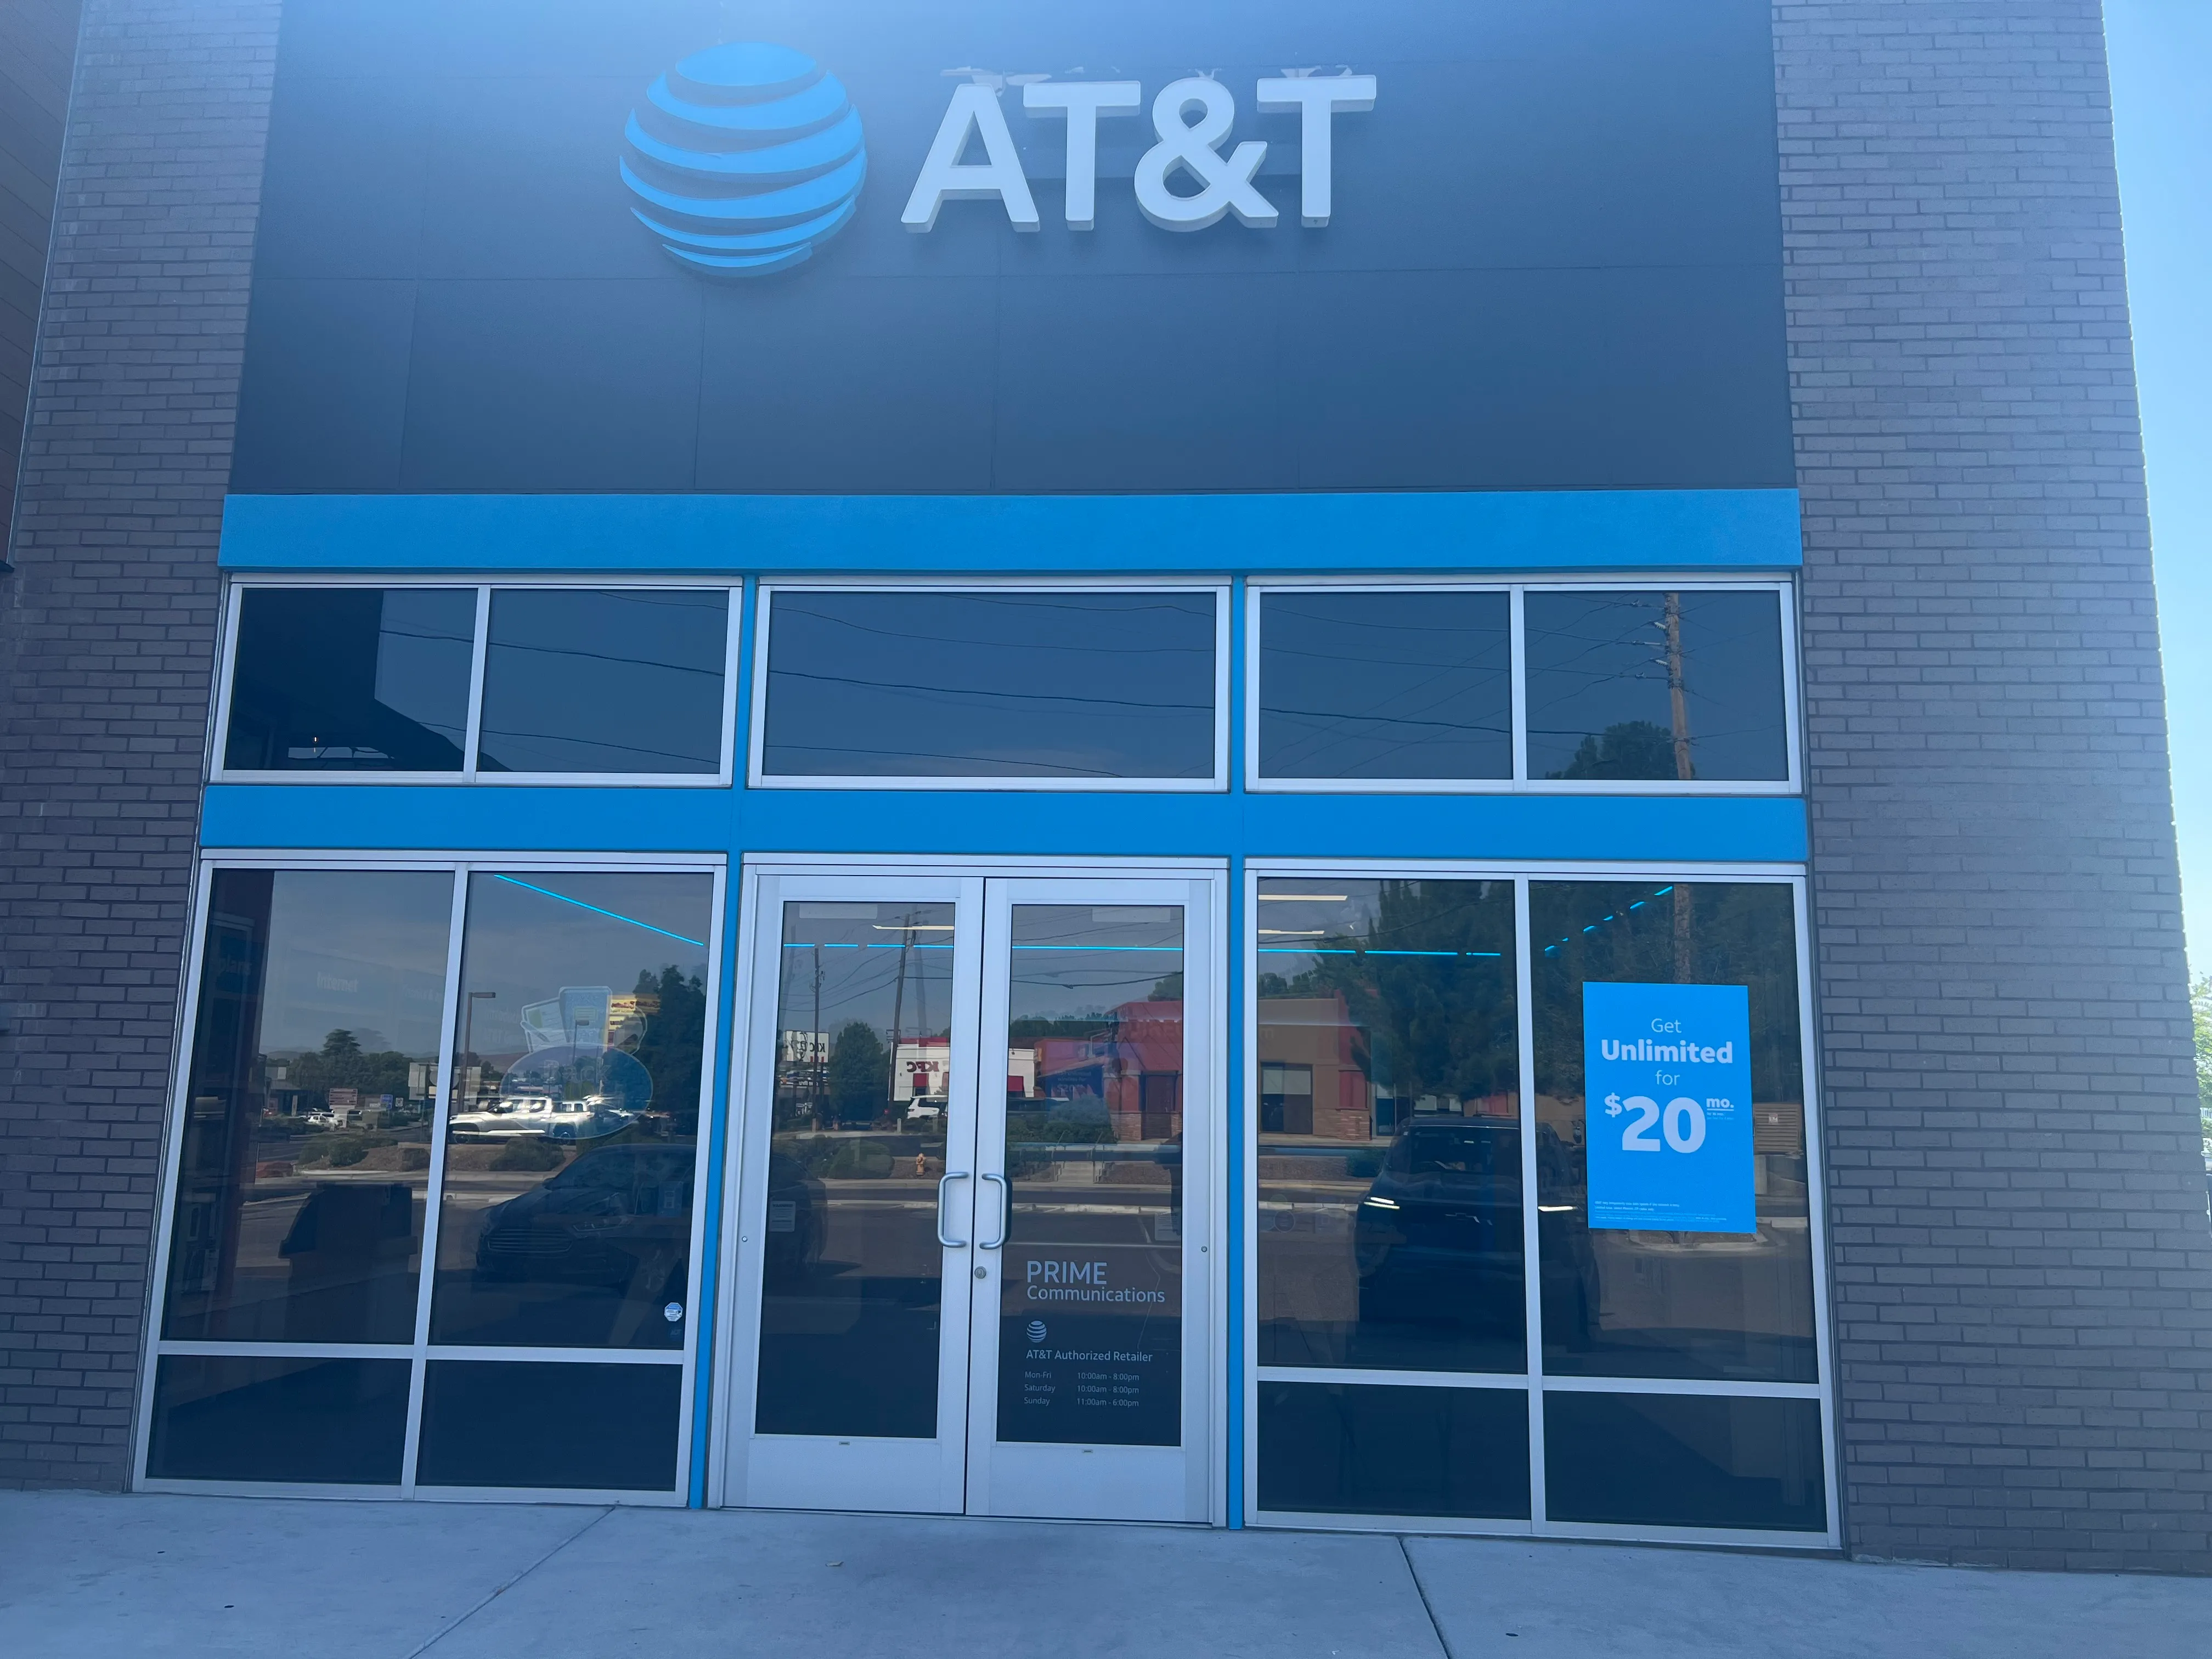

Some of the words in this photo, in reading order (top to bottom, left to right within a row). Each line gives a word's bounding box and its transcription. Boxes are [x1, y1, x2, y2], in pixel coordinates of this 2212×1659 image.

[901, 74, 1377, 233] AT&T
[1651, 1018, 1682, 1034] Get
[1601, 1039, 1734, 1064] Unlimited
[1655, 1069, 1680, 1086] for
[1604, 1092, 1707, 1154] $20
[1706, 1098, 1735, 1108] mo.
[1026, 1260, 1108, 1285] PRIME
[1026, 1285, 1165, 1303] Communications
[1026, 1350, 1052, 1359] AT&T
[1054, 1350, 1111, 1361] Authorized
[1113, 1351, 1153, 1362] Retailer
[1077, 1372, 1107, 1380] 10:00am
[1113, 1373, 1140, 1381] 8:00pm
[1024, 1384, 1056, 1393] Saturday
[1113, 1386, 1139, 1395] 8:00pm
[1024, 1397, 1050, 1406] Sunday
[1077, 1398, 1107, 1406] 11:00am
[1113, 1400, 1139, 1408] 6:00pm
